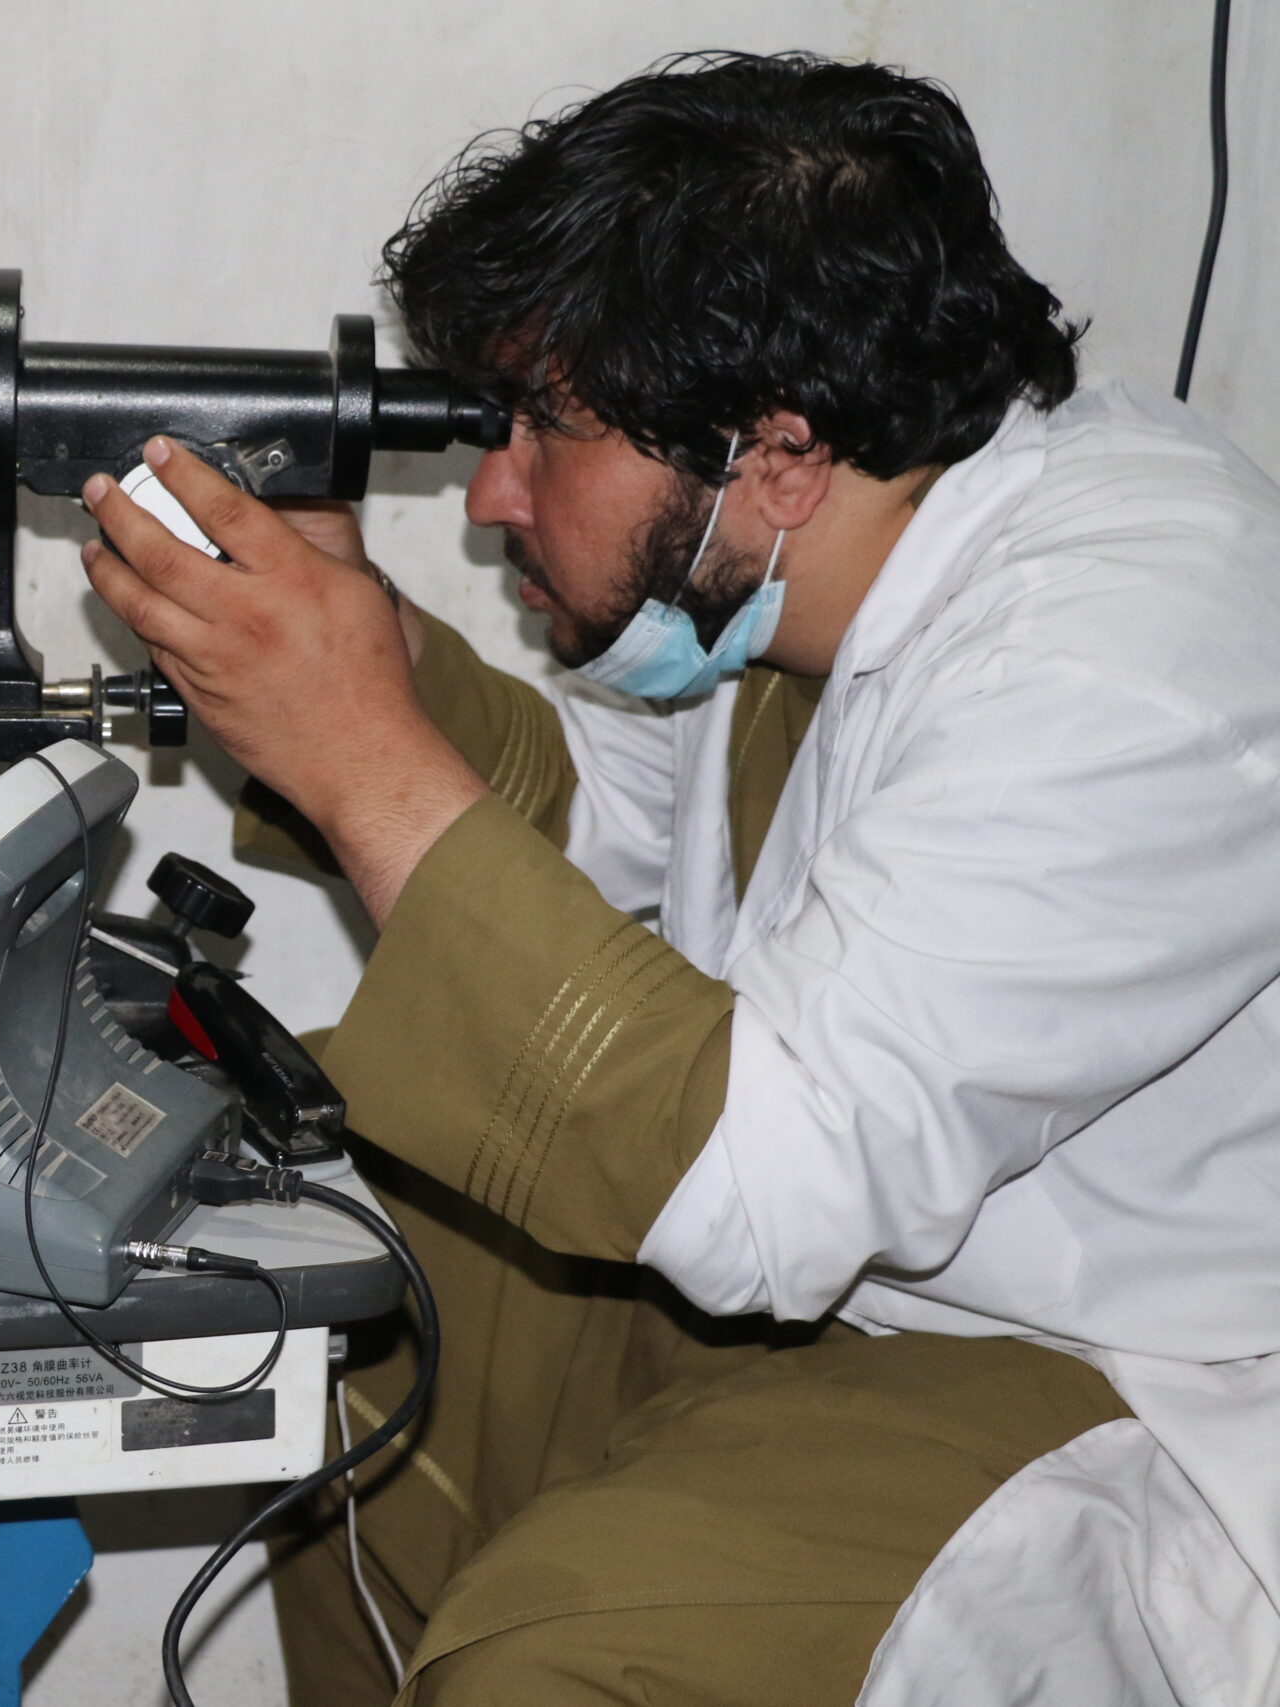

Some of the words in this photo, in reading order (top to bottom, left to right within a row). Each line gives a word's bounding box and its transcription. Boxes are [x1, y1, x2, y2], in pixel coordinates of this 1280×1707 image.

[32, 1358, 92, 1373] 角膜曲率计
[27, 1375, 70, 1387] 50/60Hz
[76, 1373, 103, 1383] 56VA
[35, 1408, 58, 1420] 警告
